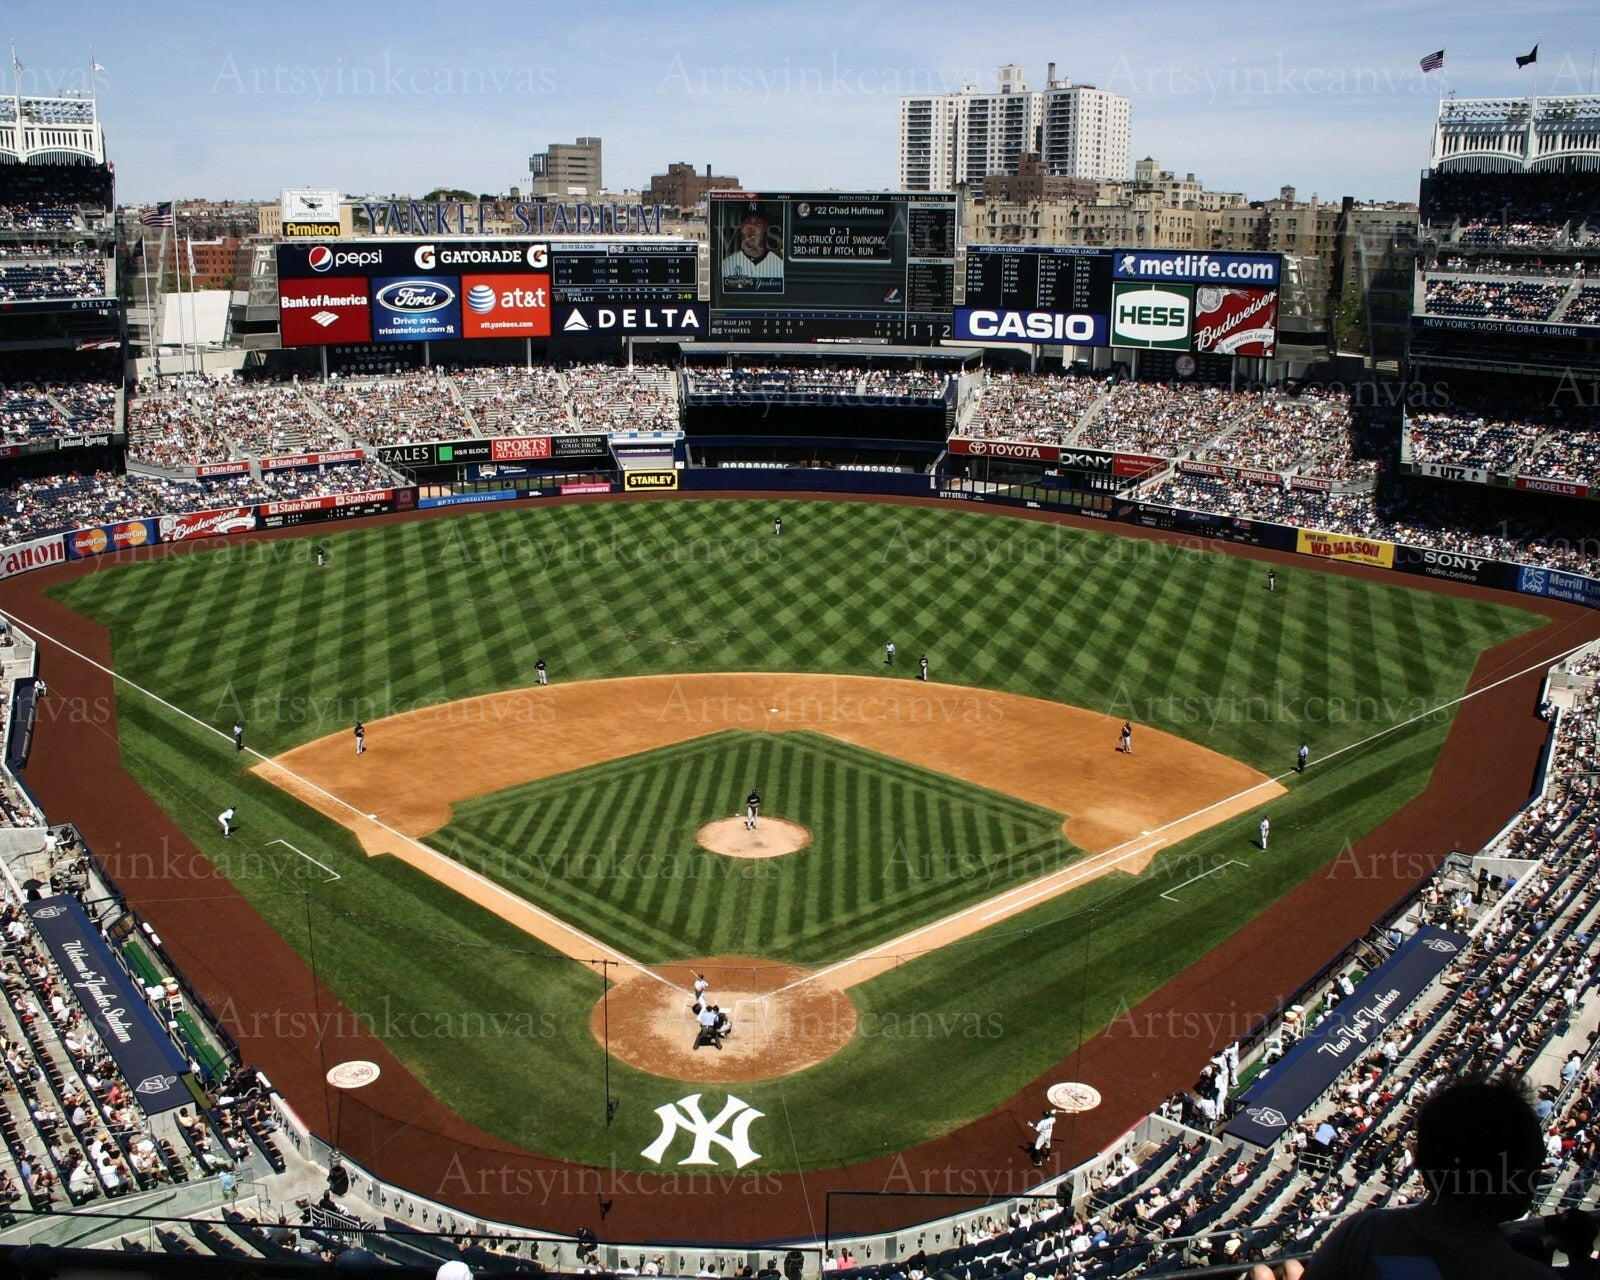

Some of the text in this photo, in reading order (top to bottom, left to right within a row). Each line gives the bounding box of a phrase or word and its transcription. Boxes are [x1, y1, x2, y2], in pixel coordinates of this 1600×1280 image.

[828, 206, 849, 215] Chad
[851, 206, 884, 215] Huffman
[361, 202, 664, 235] YANKEE STADIUM
[287, 223, 340, 236] Armitron
[829, 227, 836, 235] 0
[835, 236, 850, 244] OUT
[852, 236, 886, 245] SWINGING
[335, 249, 382, 267] pepsi
[441, 251, 522, 264] GATORADE
[822, 247, 832, 255] BY
[858, 247, 873, 256] RUN
[1139, 255, 1273, 280] metlife.com
[281, 293, 368, 309] Bank of America
[394, 287, 437, 306] Ford
[500, 287, 547, 308] at&t
[393, 317, 440, 325] Drive one.
[598, 309, 700, 328] DELTA
[1119, 305, 1185, 327] HESS
[1194, 288, 1278, 351] Budweiser
[379, 325, 445, 336] tristateford.com
[480, 321, 534, 330] att.yankees.com
[911, 325, 951, 338] 1 1 2
[969, 310, 1095, 341] CASIO
[1423, 319, 1577, 337] NEW YORK'S MOST GLOBAL AIRLINE
[59, 435, 109, 450] Poland Spring
[495, 438, 547, 451] SPORTS
[384, 447, 430, 463] ZALES
[468, 447, 489, 455] BLOCK
[989, 443, 1041, 459] TOYOTA
[1060, 452, 1113, 469] DKNY
[1183, 462, 1218, 474] MODELL'S
[630, 475, 673, 485] STANLEY
[1241, 471, 1277, 482] MODELL'S
[1292, 477, 1330, 489] MODELL'S
[1526, 480, 1577, 495] MODELL'S
[172, 509, 240, 541] Budweiser
[75, 536, 107, 549] MasterCard
[113, 530, 147, 543] MasterCard
[1424, 550, 1483, 571] SONY
[1426, 567, 1477, 581] make.believe
[1549, 573, 1582, 590] Merrill
[1548, 586, 1573, 600] Wealth
[62, 939, 89, 973] Welcome
[74, 975, 118, 1008] Yankee
[102, 1007, 132, 1043] Stadium
[1317, 988, 1400, 1058] New York Yankees
[640, 1093, 766, 1169] NY
